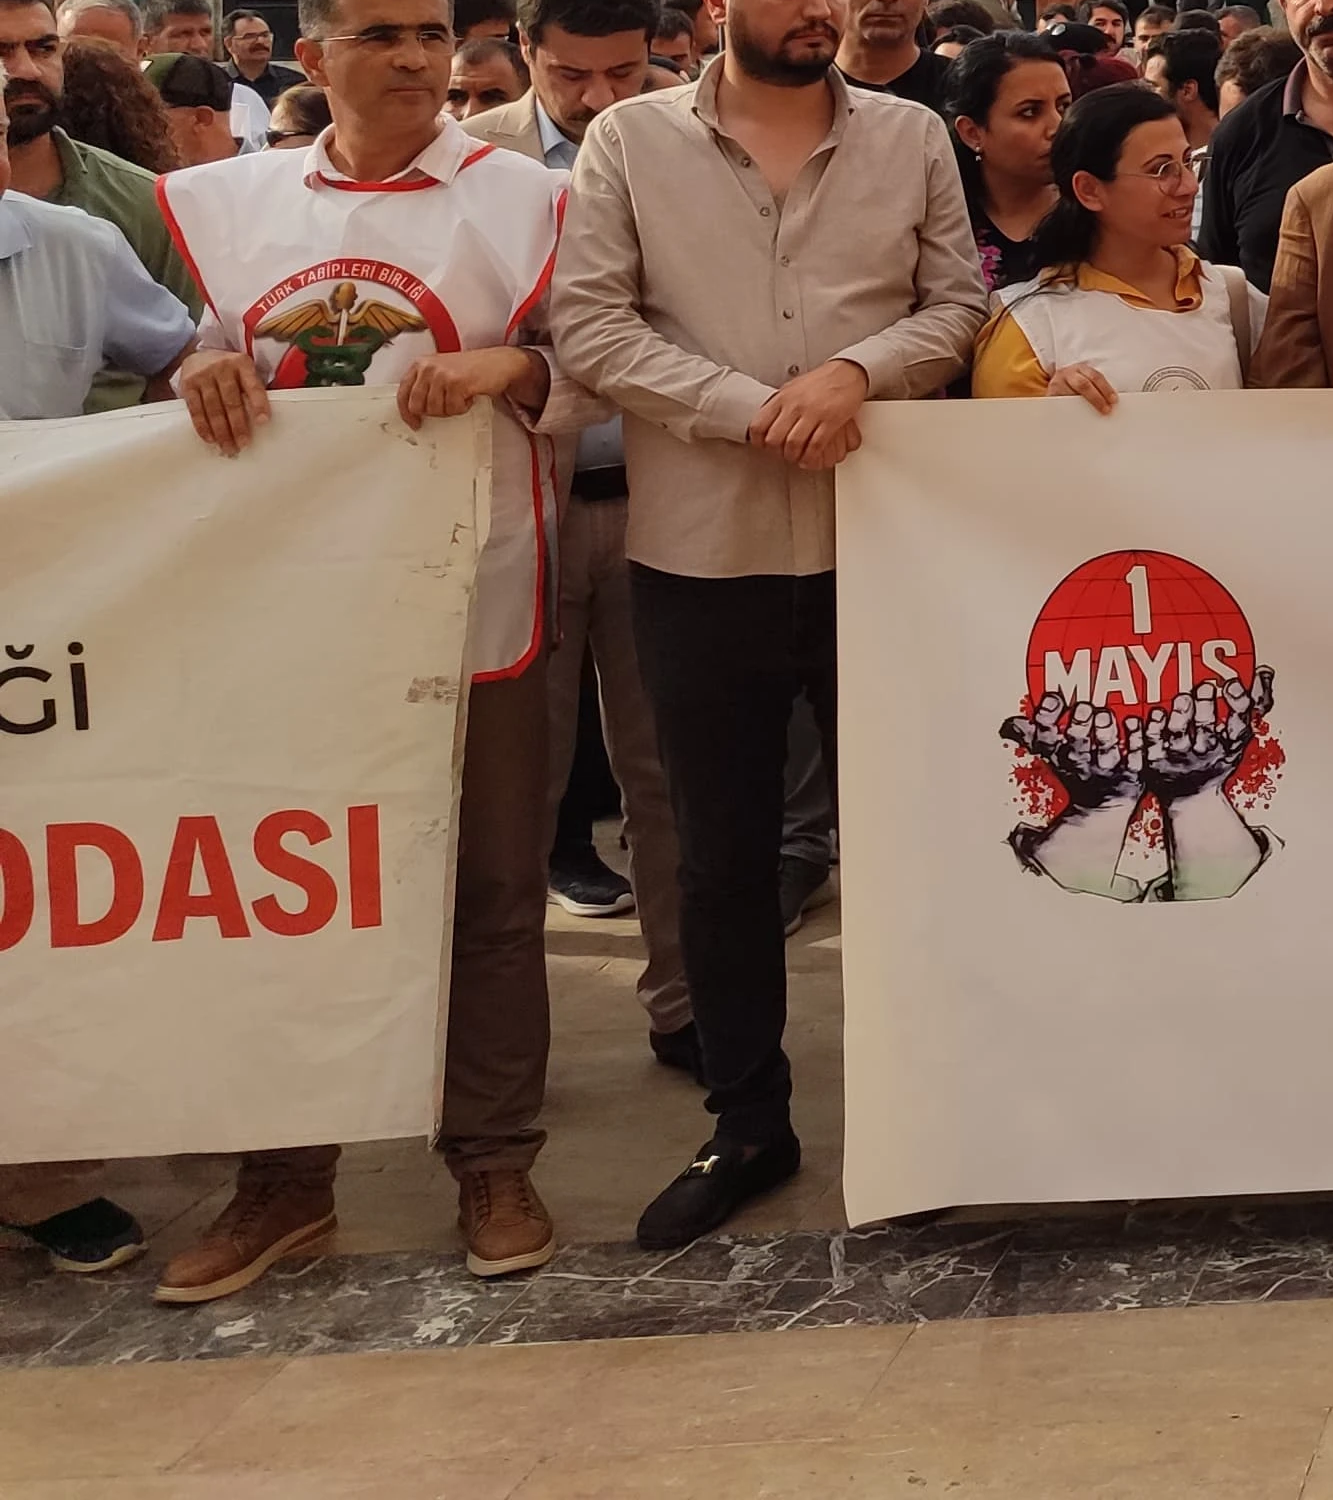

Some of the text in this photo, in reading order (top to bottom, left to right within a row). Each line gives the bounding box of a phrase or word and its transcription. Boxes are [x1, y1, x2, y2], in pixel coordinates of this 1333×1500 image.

[296, 261, 377, 289] TABİPLERİ
[1125, 564, 1153, 635] 1
[1044, 638, 1239, 708] MAYIS
